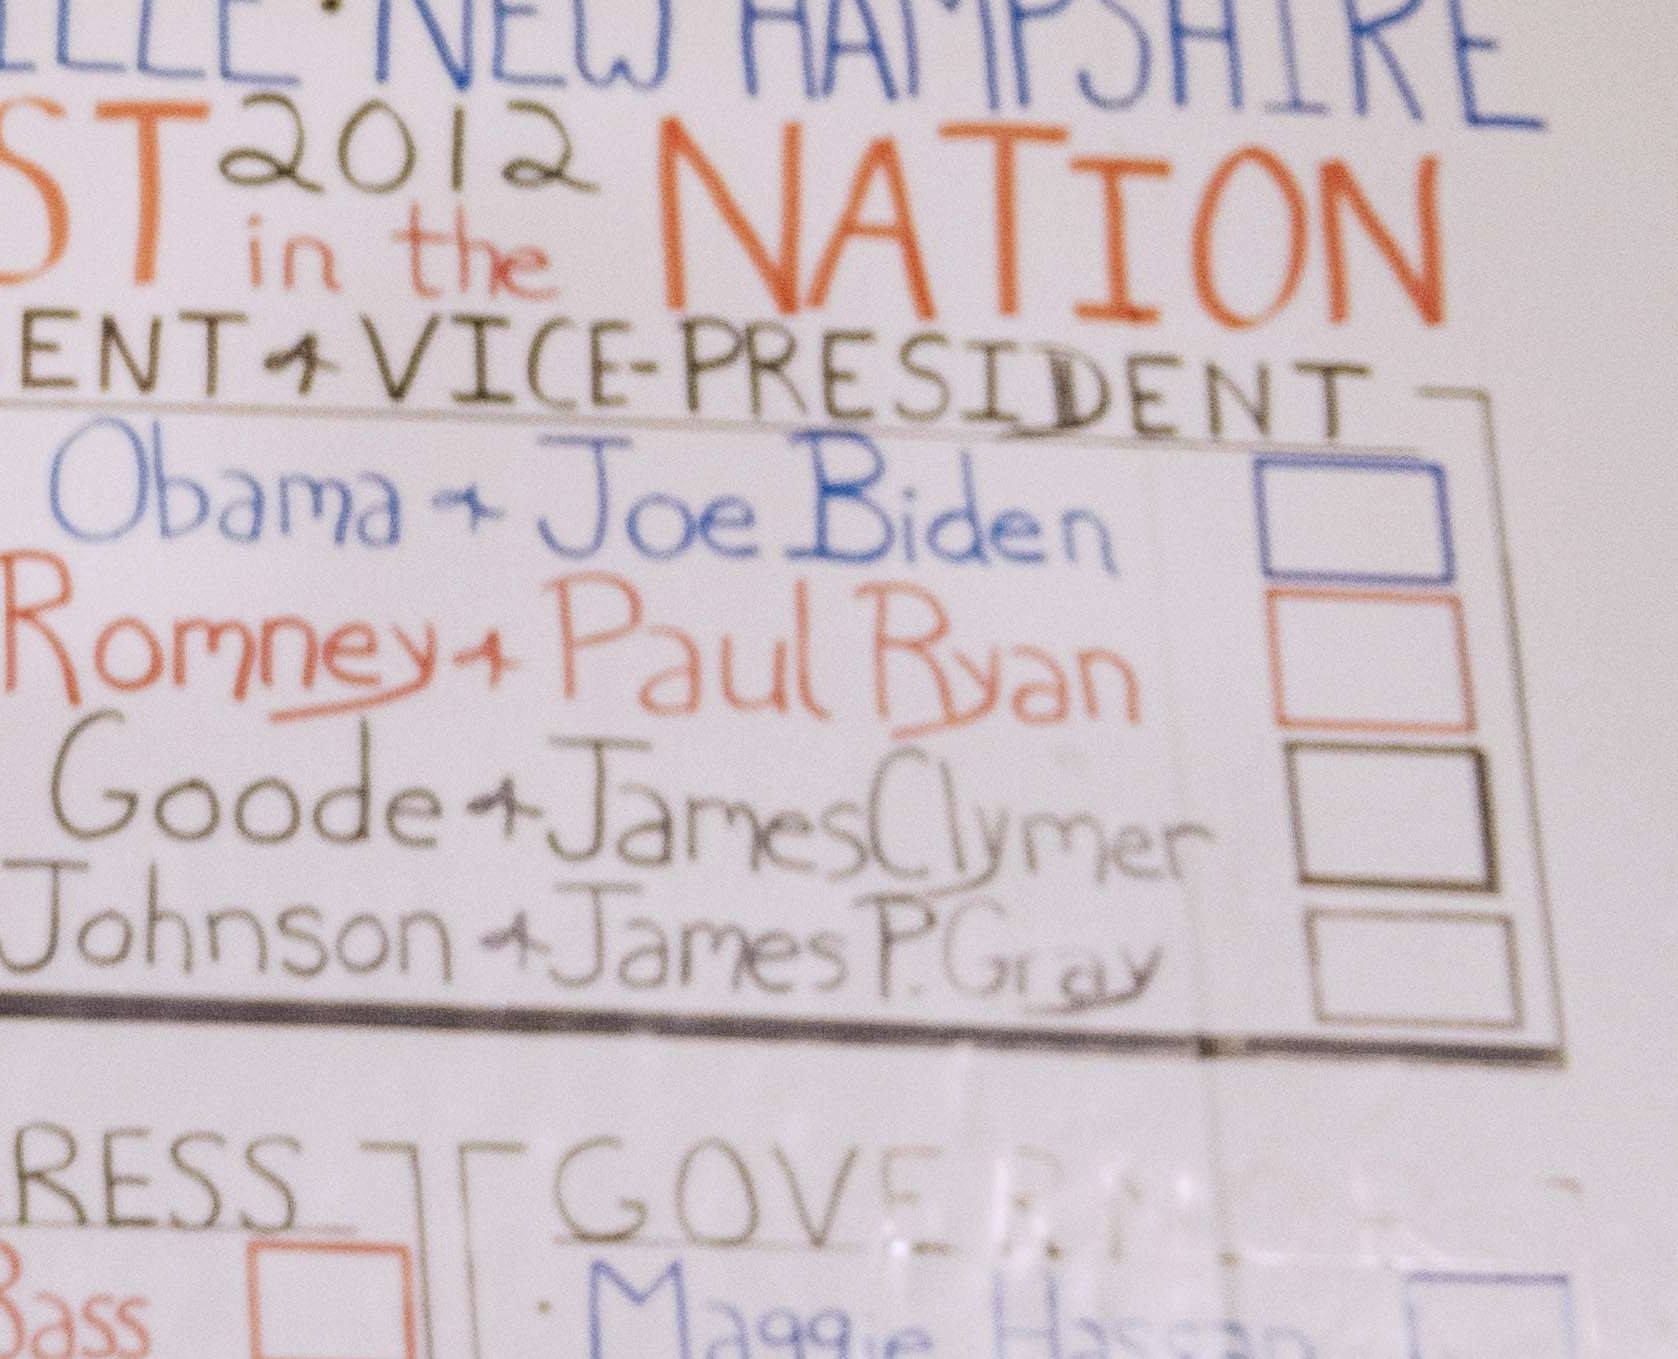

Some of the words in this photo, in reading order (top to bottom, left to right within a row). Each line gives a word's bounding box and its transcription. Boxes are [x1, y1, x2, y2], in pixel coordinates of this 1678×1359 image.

[218, 92, 600, 196] 2012
[245, 212, 341, 296] in
[390, 200, 560, 301] the
[656, 114, 1446, 330] NATION
[358, 314, 1373, 440] VICE-PRESIDENT
[49, 415, 403, 547] Obama
[537, 435, 759, 563] Joe
[785, 428, 1120, 576] Biden
[542, 570, 830, 721] Paul
[852, 580, 1142, 741] Ryan
[50, 707, 446, 849] Goode
[545, 736, 870, 882] James
[547, 882, 848, 994] James
